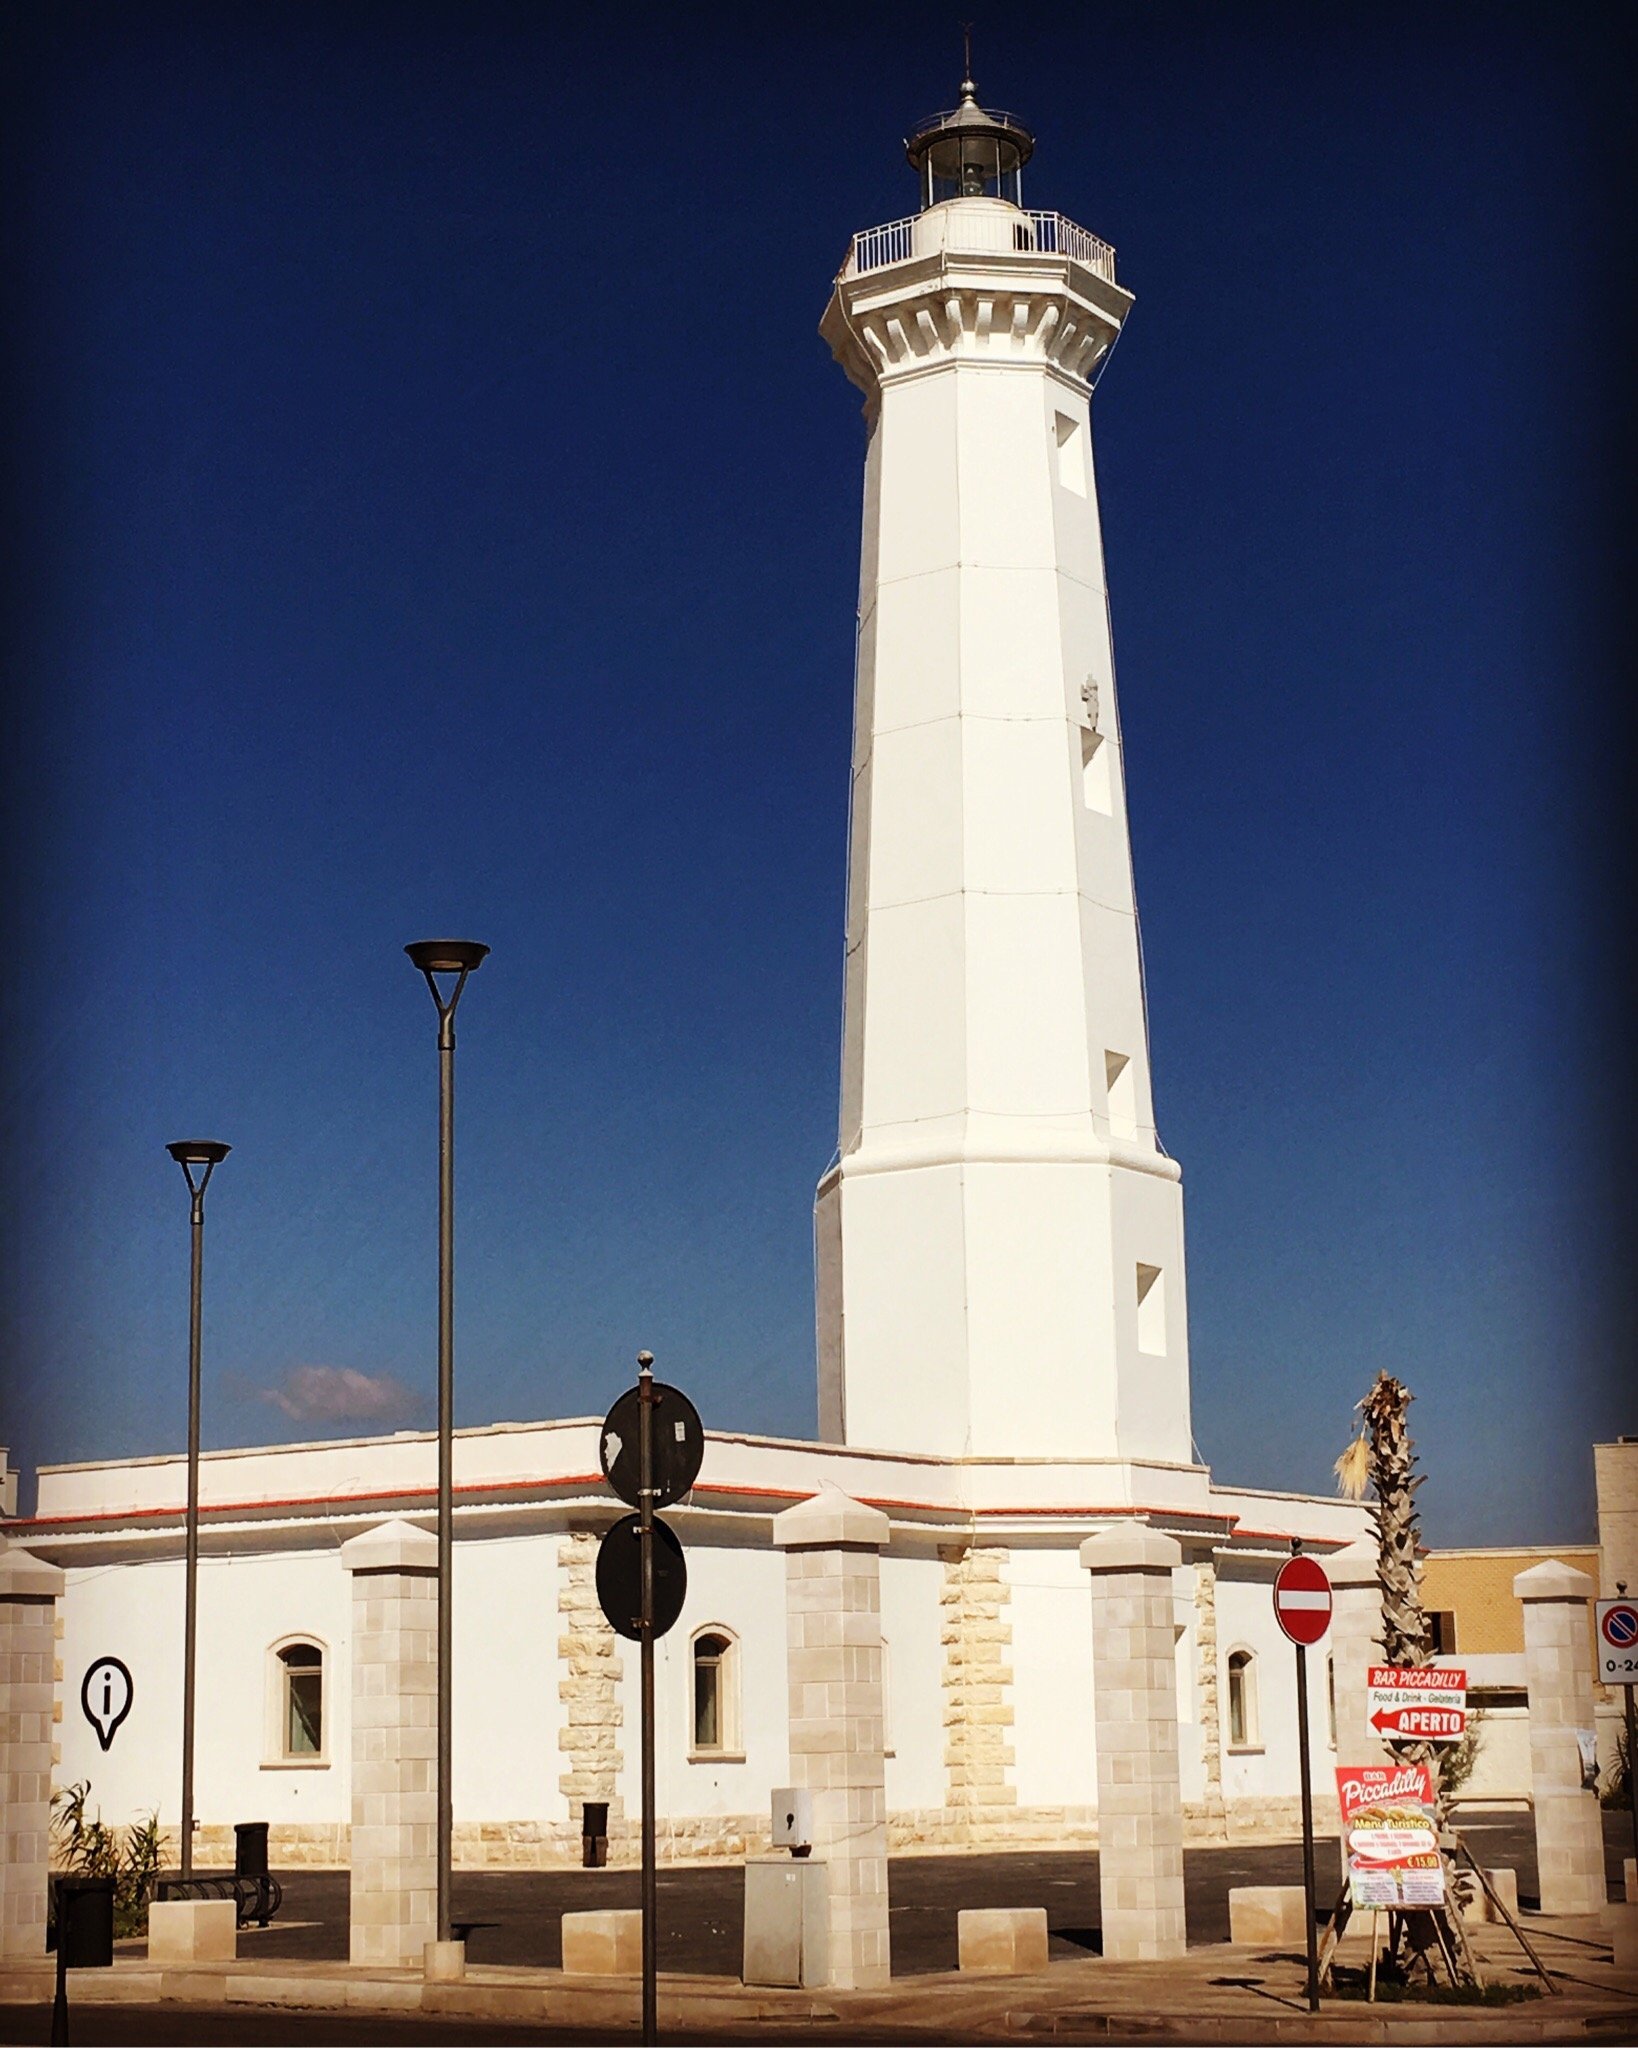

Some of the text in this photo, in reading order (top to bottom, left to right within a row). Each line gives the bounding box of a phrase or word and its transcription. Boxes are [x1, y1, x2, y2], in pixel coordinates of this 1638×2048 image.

[1373, 1670, 1461, 1687] BAR PICCADILLY
[1373, 1691, 1392, 1702] Food
[1394, 1692, 1400, 1702] &
[1402, 1693, 1421, 1703] Drink
[1428, 1693, 1461, 1704] Gelateria
[1398, 1711, 1461, 1732] APERTO
[1365, 1772, 1384, 1780] BAR
[1342, 1767, 1426, 1808] Piccadilly
[1386, 1818, 1430, 1829] Turistico
